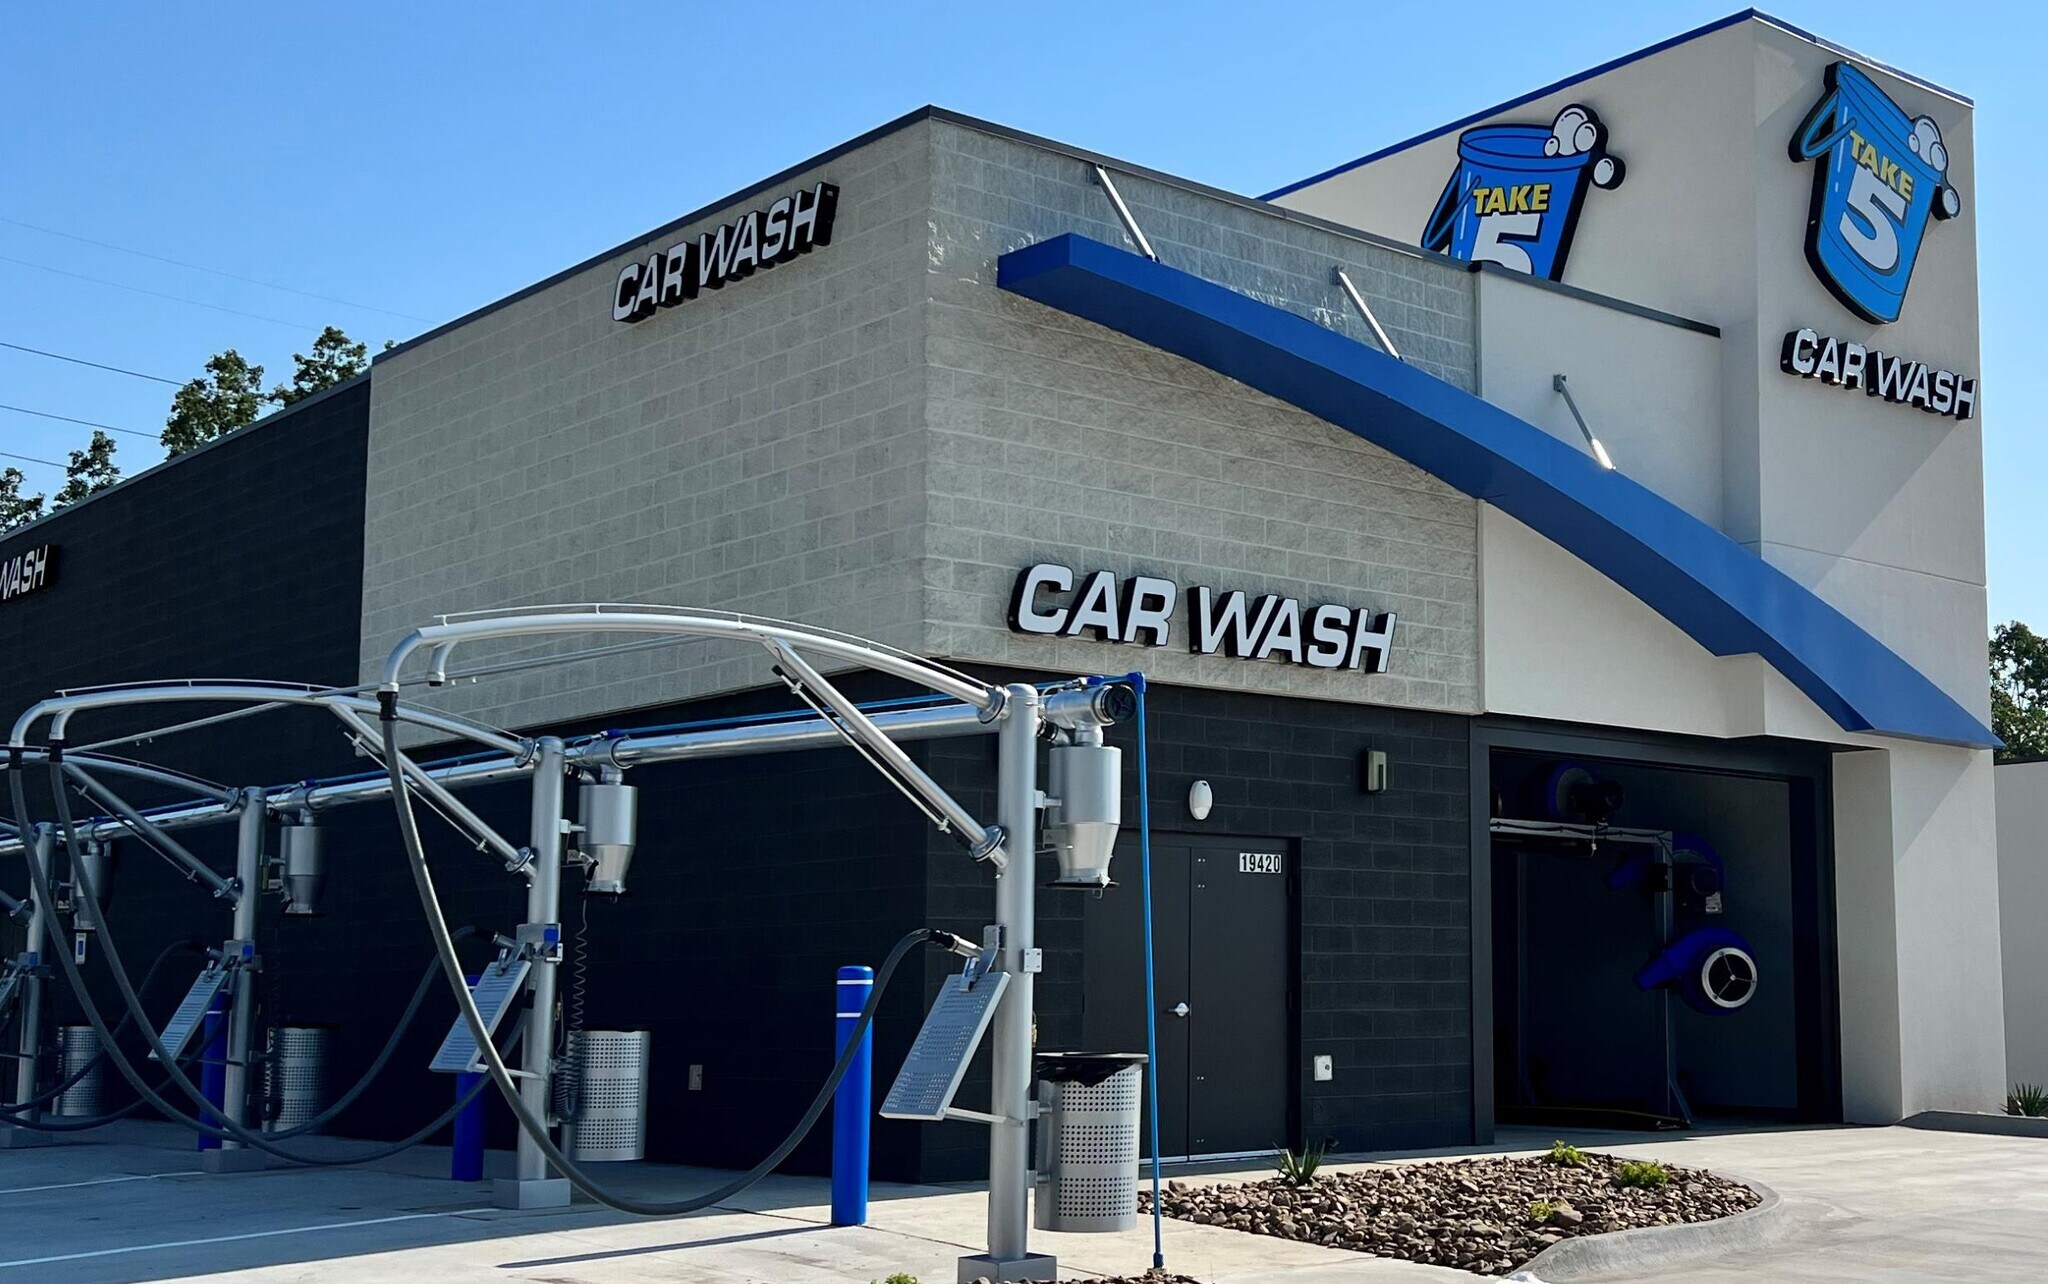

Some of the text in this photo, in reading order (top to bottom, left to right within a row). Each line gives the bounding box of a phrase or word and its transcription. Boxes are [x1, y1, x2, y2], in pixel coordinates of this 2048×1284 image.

[1473, 184, 1551, 215] TAKE
[1850, 130, 1915, 203] TAKE
[613, 182, 823, 321] CAR WASH
[1471, 211, 1541, 275] 5
[1839, 164, 1907, 272] 5
[1792, 328, 1978, 420] CAR WASH
[1017, 562, 1398, 674] CAR WASH
[1241, 853, 1281, 873] 19420
